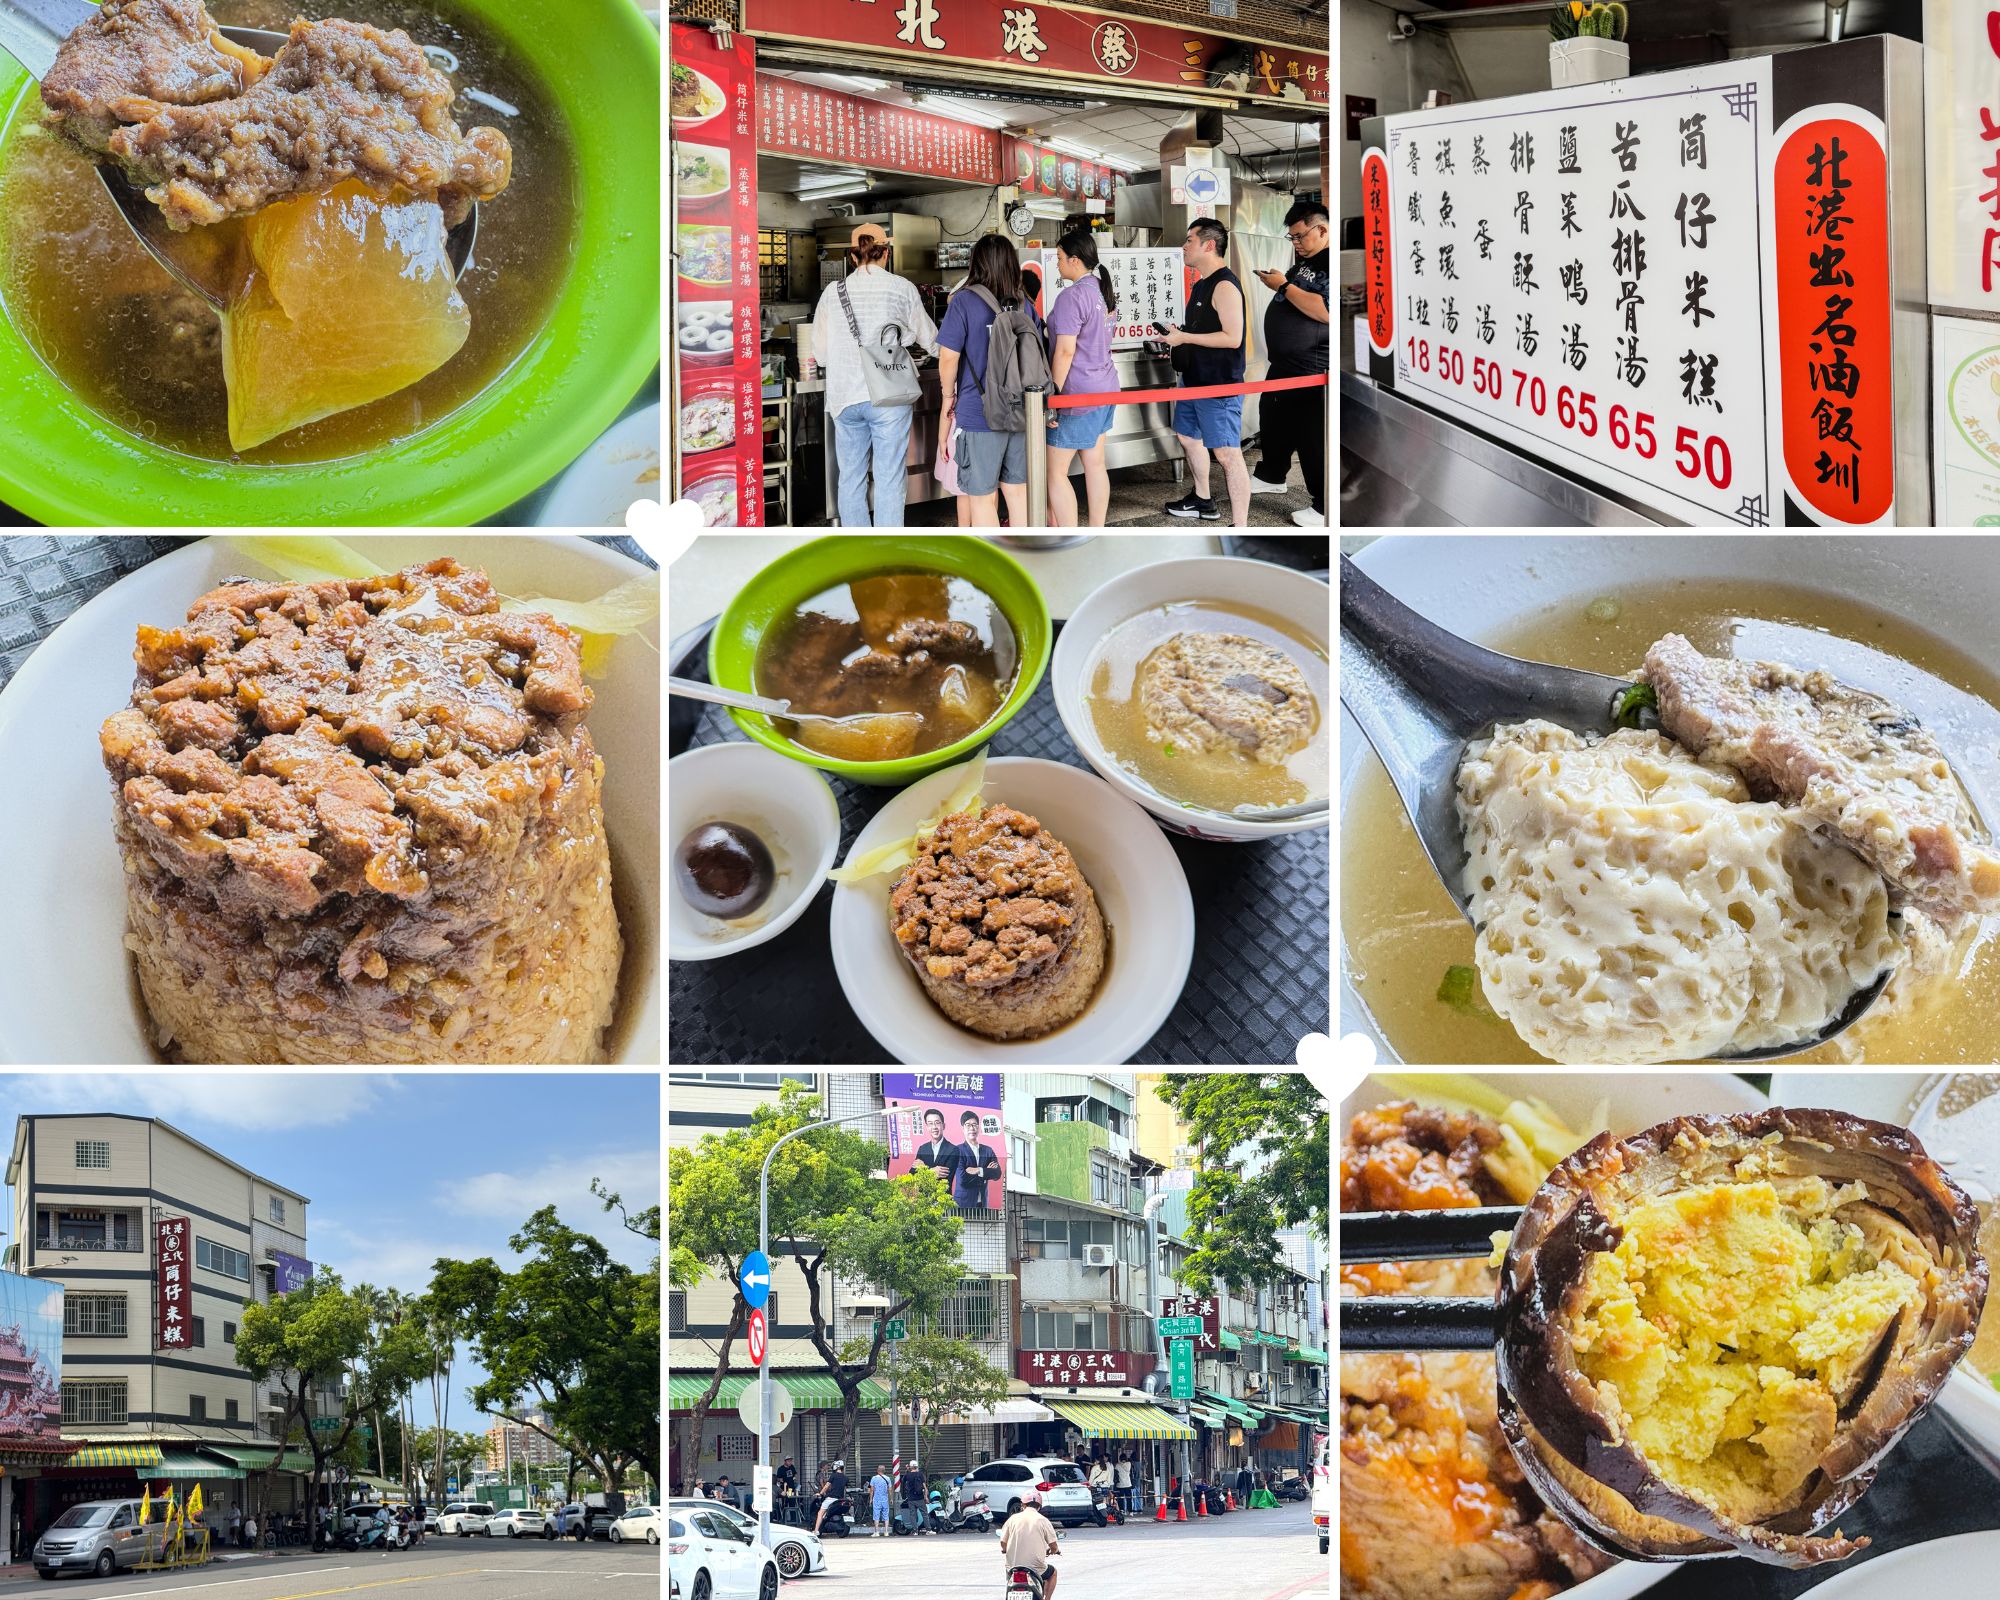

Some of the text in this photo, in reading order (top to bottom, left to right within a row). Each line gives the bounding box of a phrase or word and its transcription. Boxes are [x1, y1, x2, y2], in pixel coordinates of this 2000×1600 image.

[735, 82, 750, 136] 筒仔米糕
[737, 167, 750, 207] 蒸蛋湯
[738, 233, 752, 287] 排骨酥湯
[1435, 138, 1459, 335] 旗魚環湯
[1473, 135, 1497, 344] 蒸蛋湯
[1509, 130, 1540, 357] 排骨酥湯
[1557, 125, 1589, 372] 鹽菜鴨湯
[1609, 120, 1649, 389] 苦瓜排骨湯
[1674, 112, 1724, 414] 筒仔米糕
[739, 306, 754, 360] 旗魚環湯
[1129, 325, 1143, 337] 65
[1805, 135, 1861, 505] 北港出名油飯圳
[1407, 336, 1733, 490] 18 50 50 70 65 65 50
[743, 459, 758, 527] 苦瓜排骨湯
[914, 1073, 984, 1092] TECH高雄
[161, 1222, 185, 1236] 北港
[161, 1251, 184, 1263] 三代
[164, 1264, 185, 1343] 筒仔米糕
[1044, 1370, 1107, 1383] 筒仔米糕
